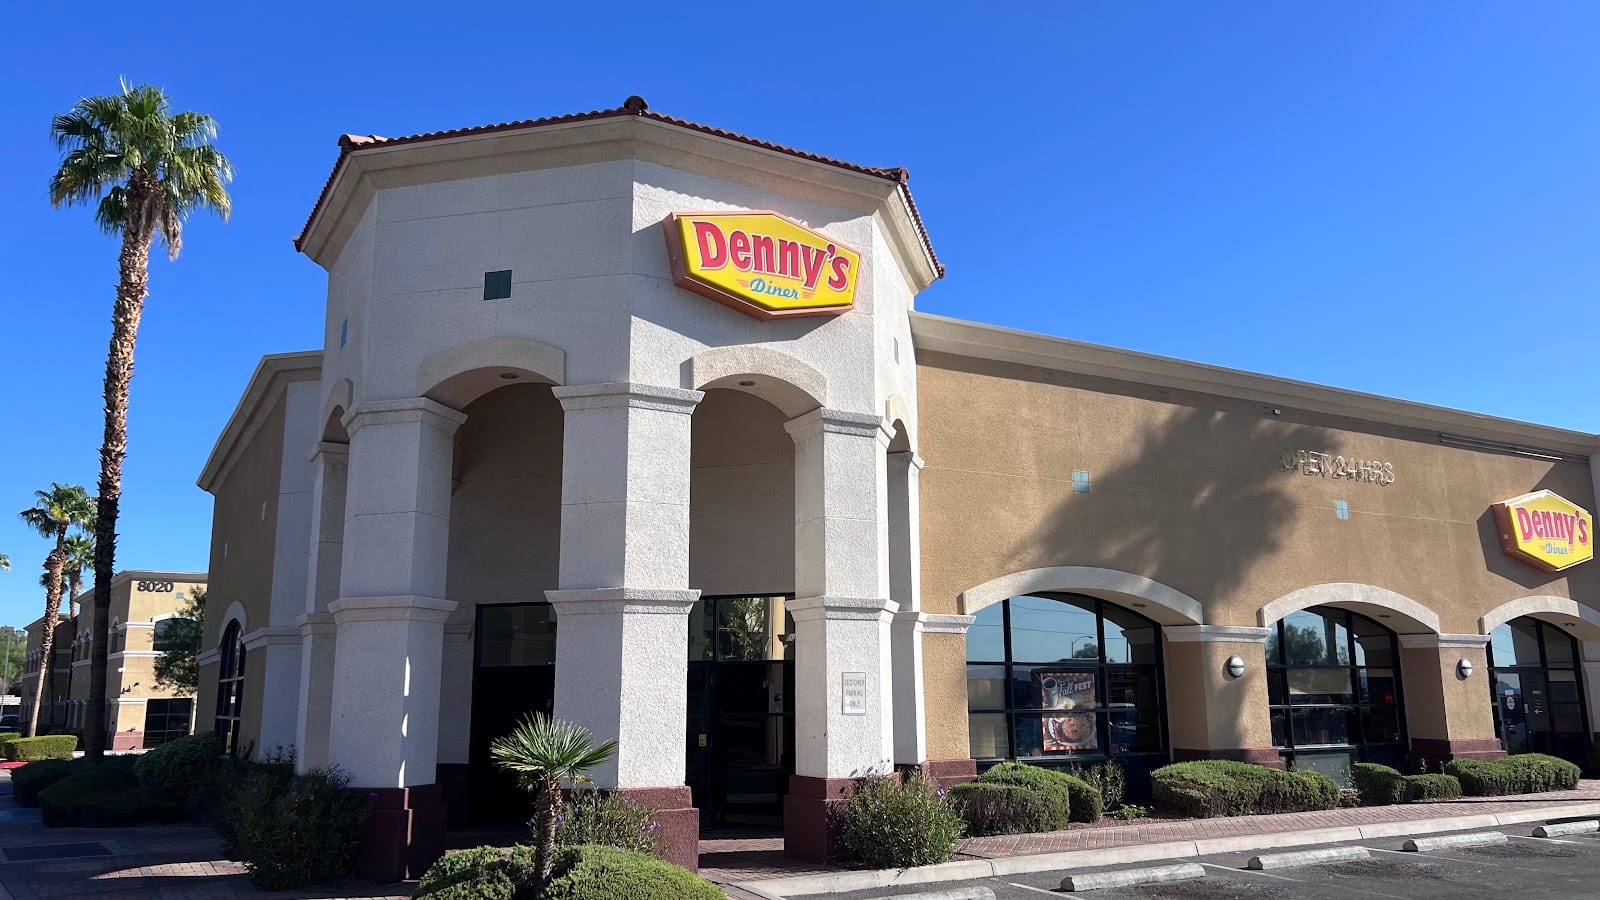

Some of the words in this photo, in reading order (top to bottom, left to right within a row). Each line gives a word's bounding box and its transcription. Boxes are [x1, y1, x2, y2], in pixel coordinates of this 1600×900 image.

[692, 221, 851, 291] Denny's
[750, 278, 799, 300] Diner
[1515, 507, 1588, 545] Denny's
[137, 580, 174, 593] 8020
[1059, 681, 1074, 697] Fall
[1074, 681, 1092, 692] FEST
